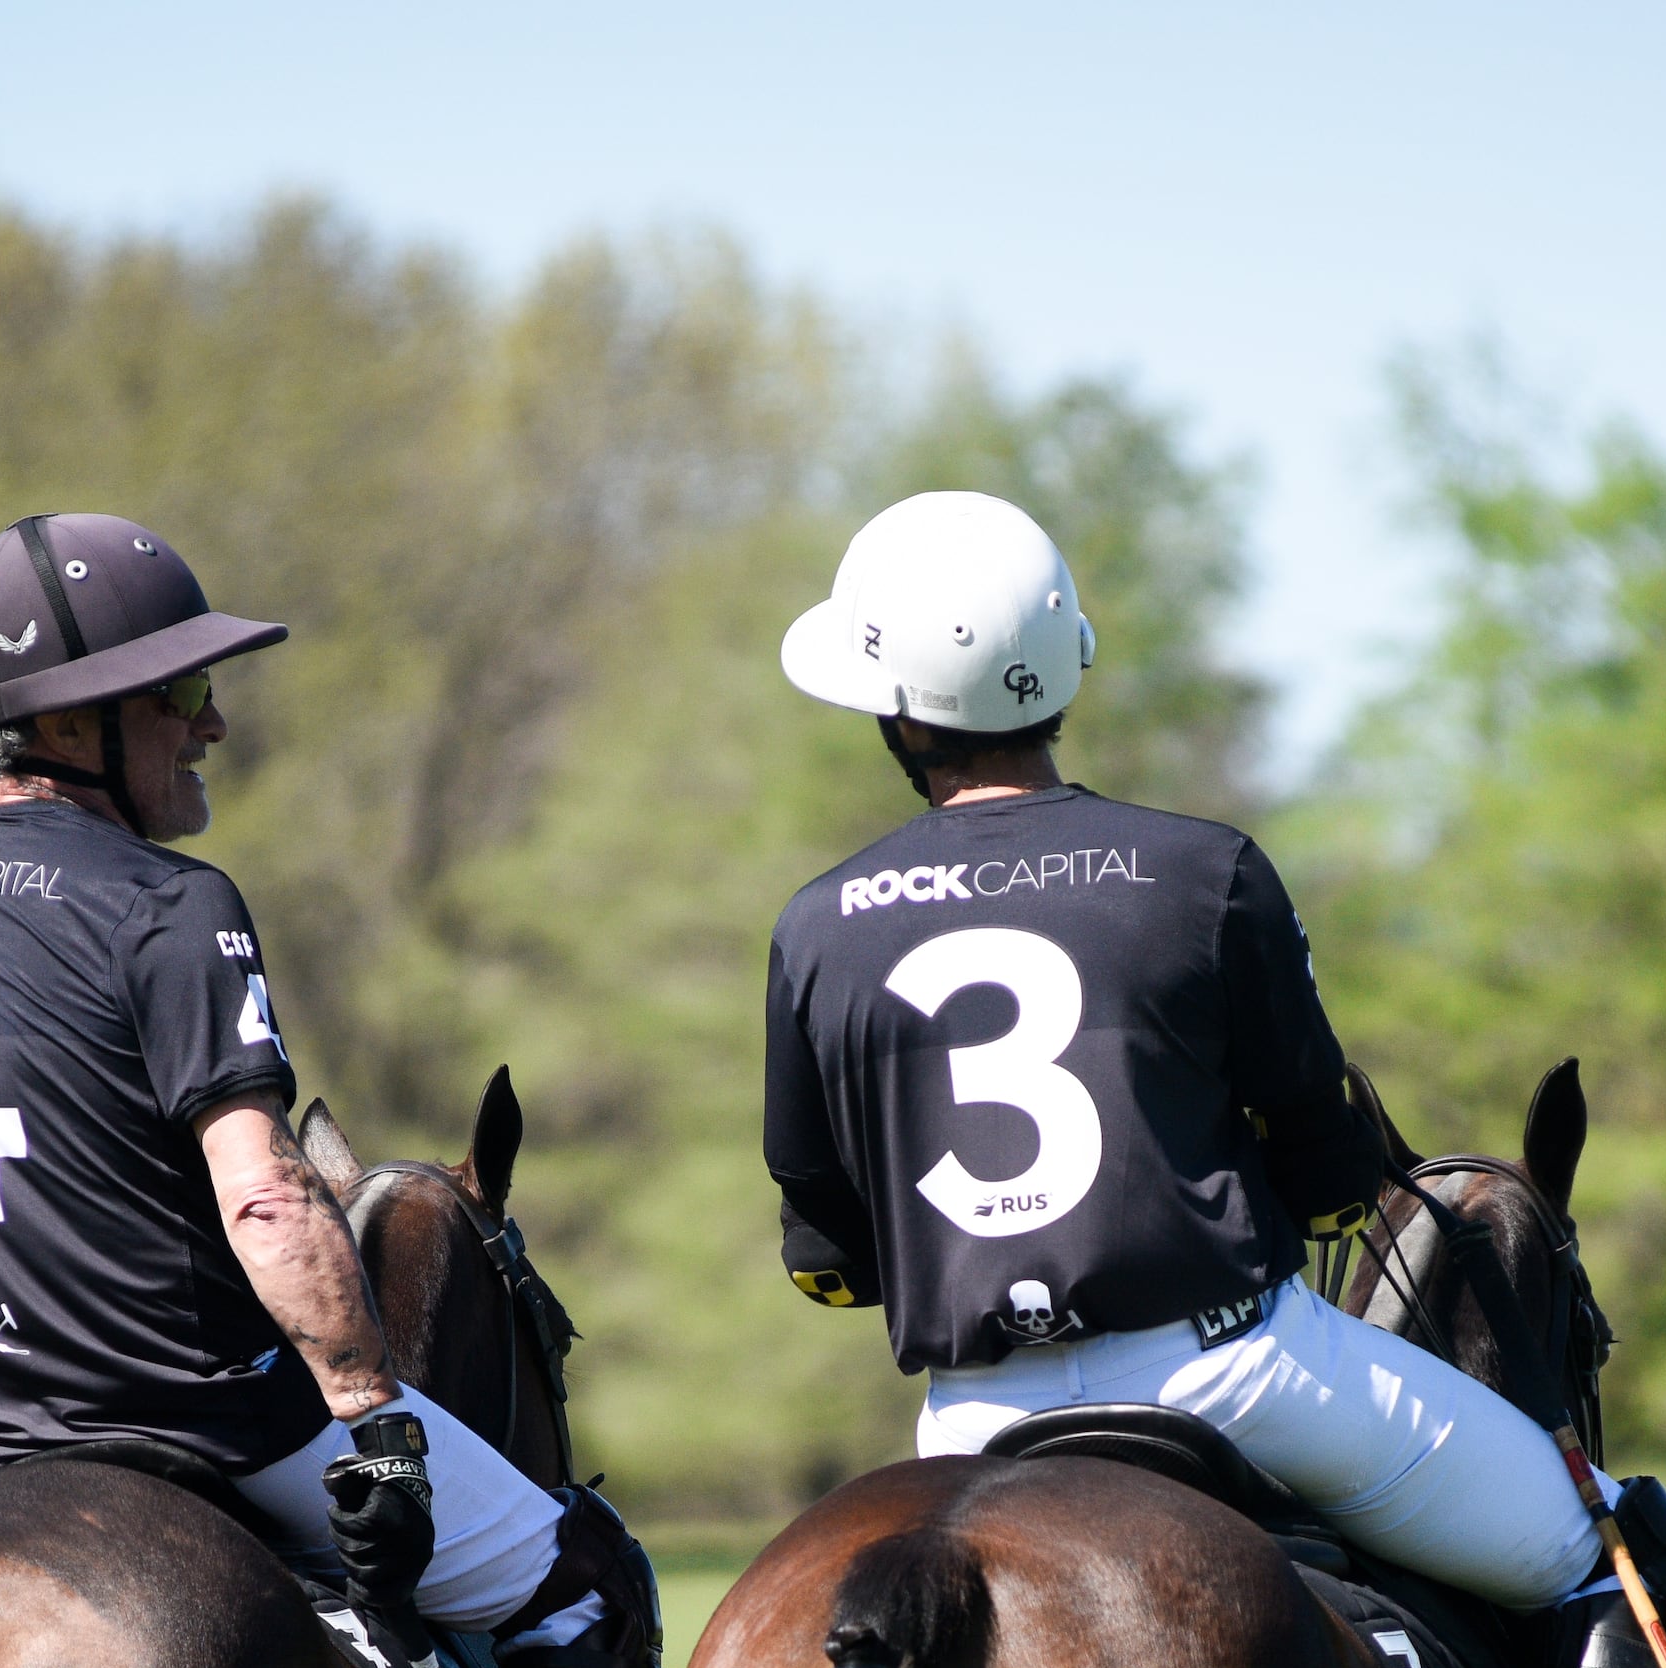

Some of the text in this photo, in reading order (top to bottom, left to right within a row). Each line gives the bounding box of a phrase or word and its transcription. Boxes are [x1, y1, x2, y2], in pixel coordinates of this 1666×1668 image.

[841, 848, 1156, 916] ROCK CAPITAL
[883, 928, 1103, 1237] 3
[1001, 1193, 1048, 1214] RUS
